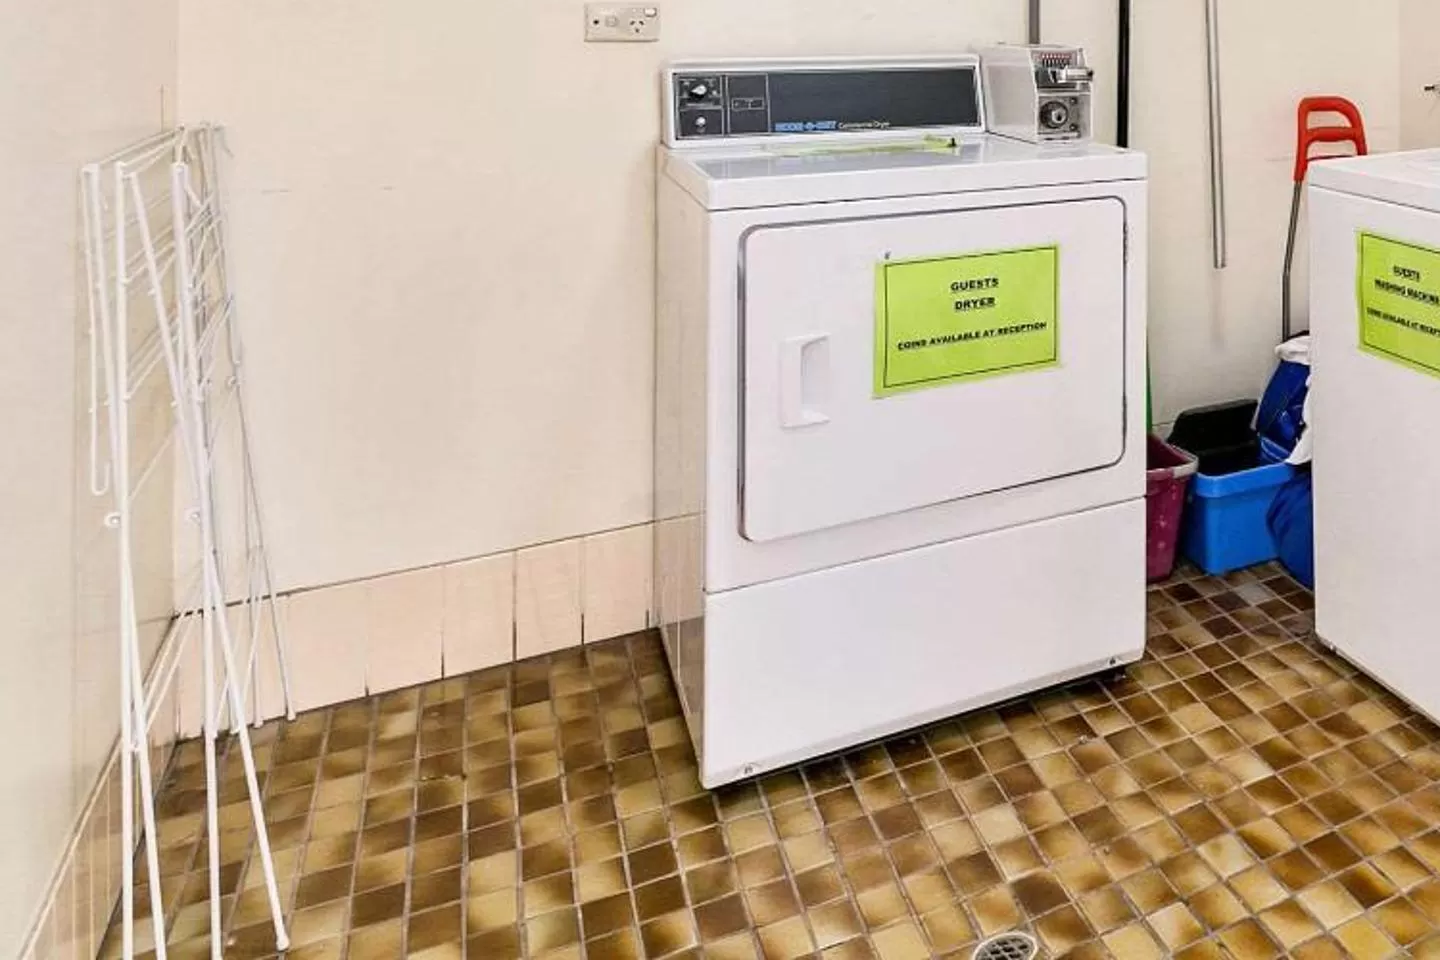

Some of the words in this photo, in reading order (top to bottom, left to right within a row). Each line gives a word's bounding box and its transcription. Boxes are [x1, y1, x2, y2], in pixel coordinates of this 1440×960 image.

[950, 277, 999, 292] GUESTS
[954, 296, 996, 311] DRYER
[898, 339, 927, 351] COINS
[929, 331, 979, 346] AVAILABLE
[982, 328, 994, 338] AT
[996, 321, 1047, 336] RECEPTION
